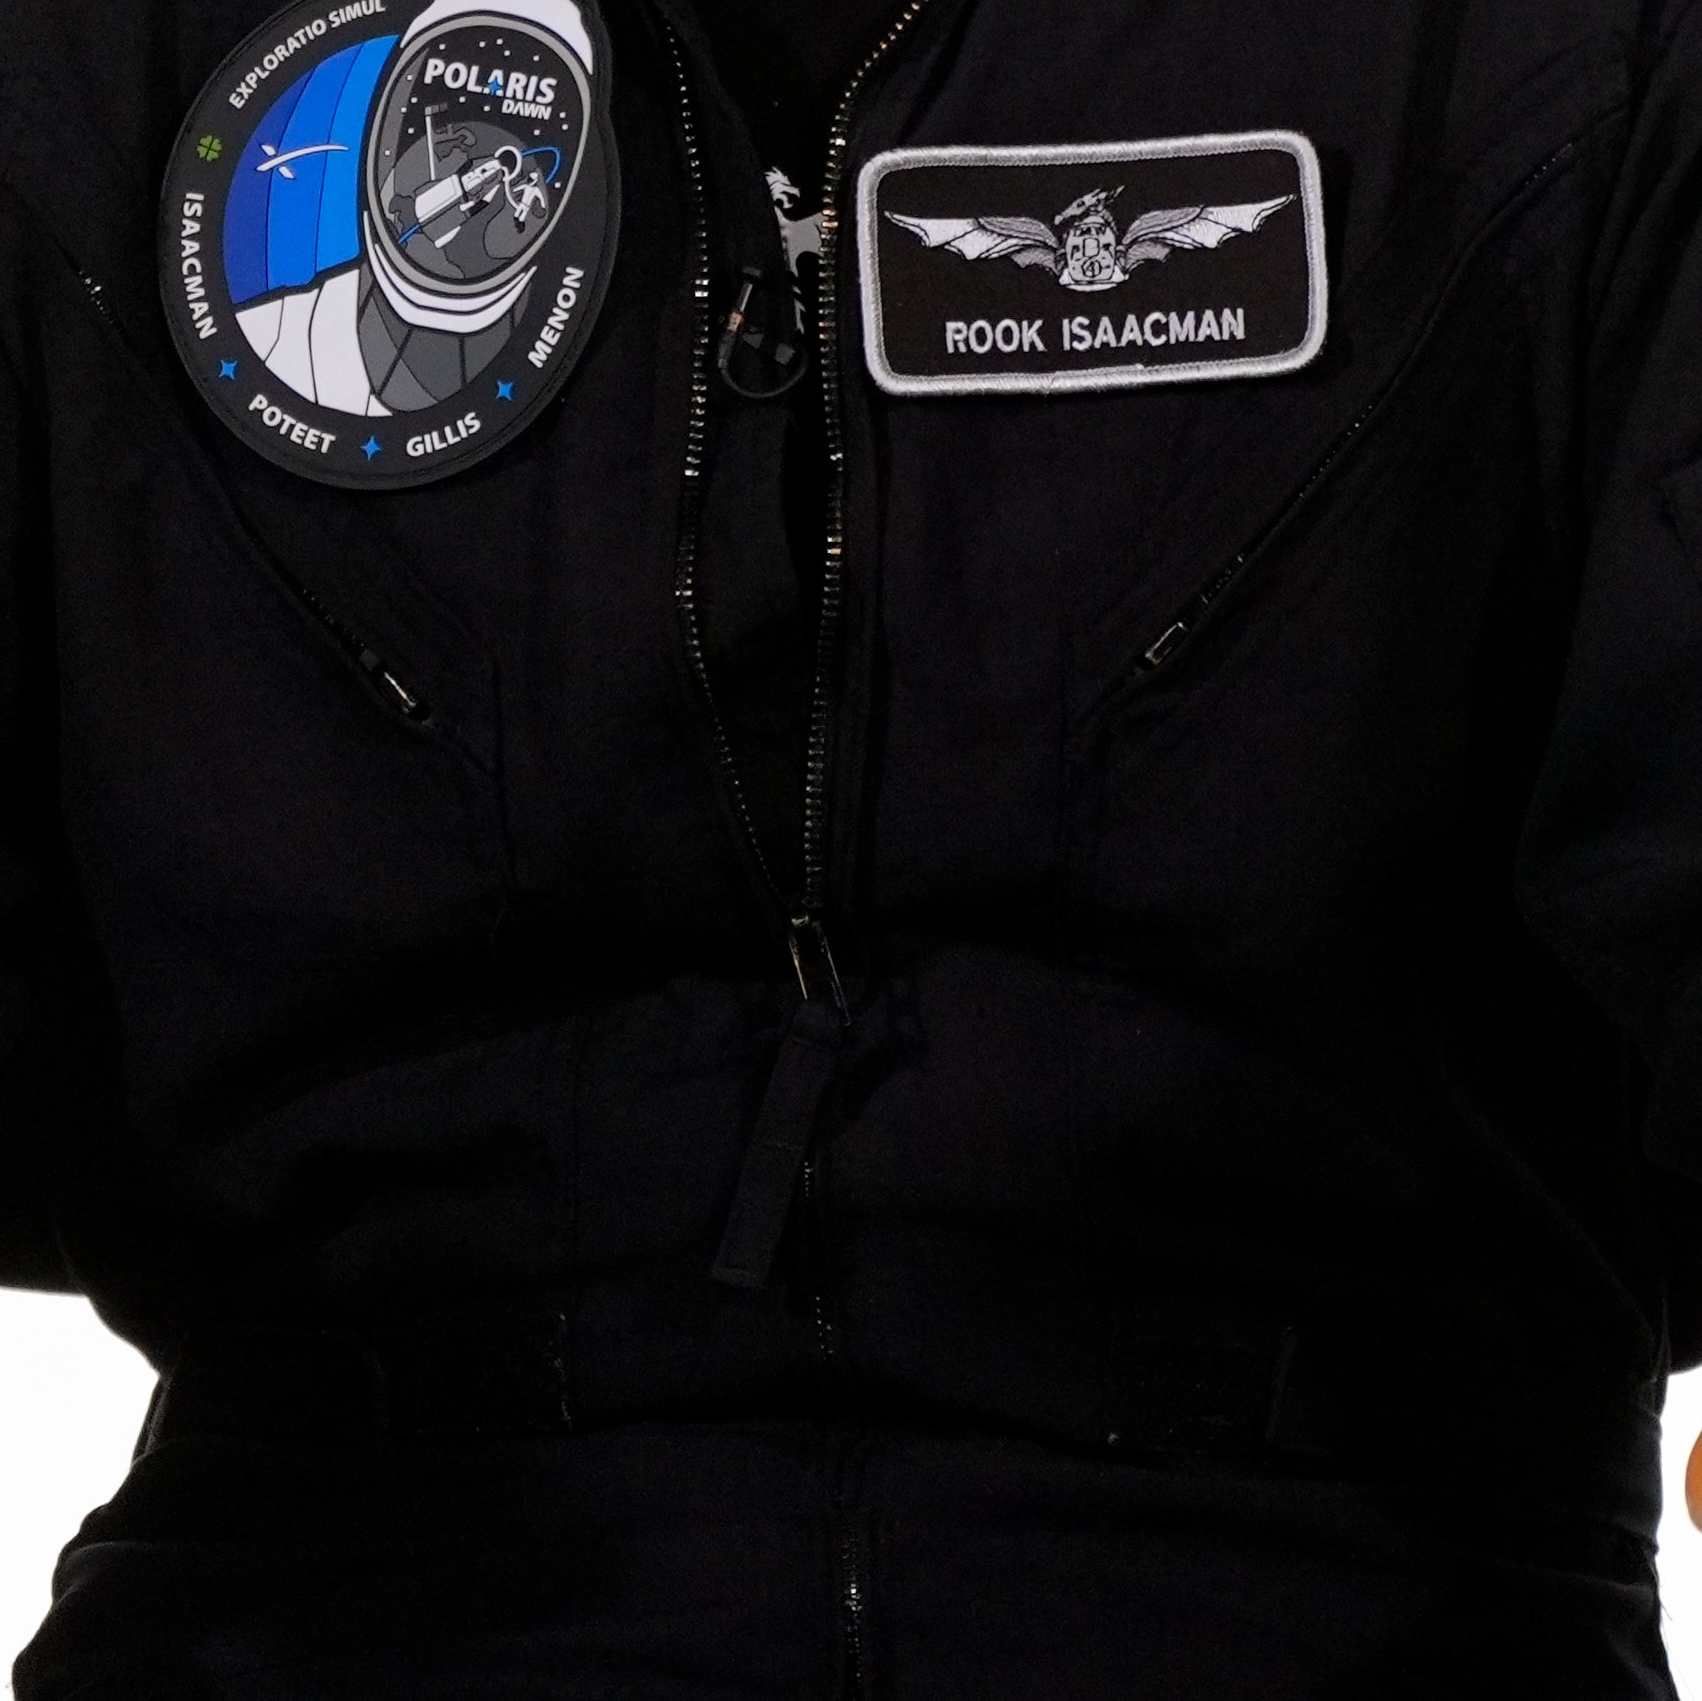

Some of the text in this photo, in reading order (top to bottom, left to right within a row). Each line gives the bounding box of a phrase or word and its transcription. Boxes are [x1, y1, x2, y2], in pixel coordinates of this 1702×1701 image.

[228, 18, 328, 110] EXPLORATIO
[423, 57, 558, 104] POLARIS
[501, 99, 552, 121] DAWN
[180, 192, 218, 340] ISAACMAN
[527, 266, 585, 369] MENON
[945, 307, 1246, 354] ROOK ISAACMAN
[248, 394, 336, 454] POTEET
[405, 411, 481, 457] GILLIS
